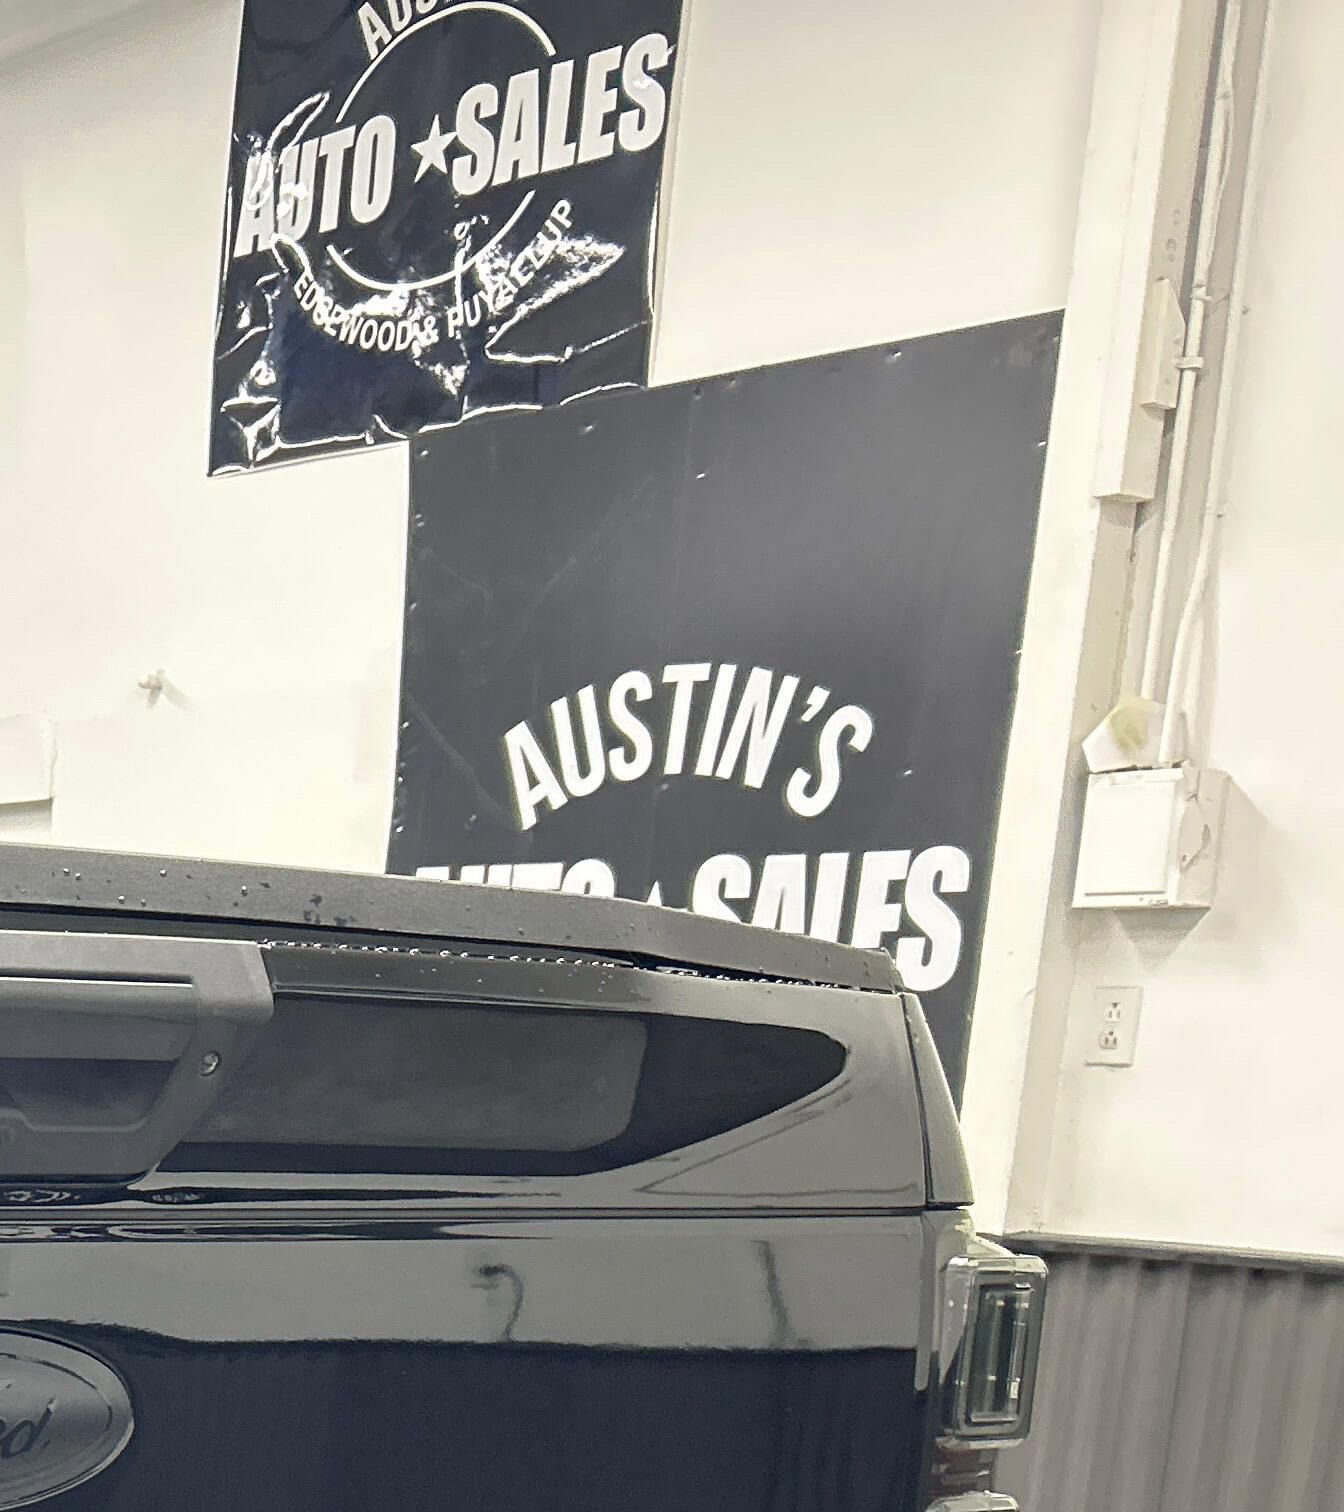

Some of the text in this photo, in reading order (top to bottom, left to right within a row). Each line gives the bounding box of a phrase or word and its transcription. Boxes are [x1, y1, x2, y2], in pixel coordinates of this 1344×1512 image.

[233, 32, 669, 259] AUTO SALES
[504, 662, 874, 831] AUSTIN'S
